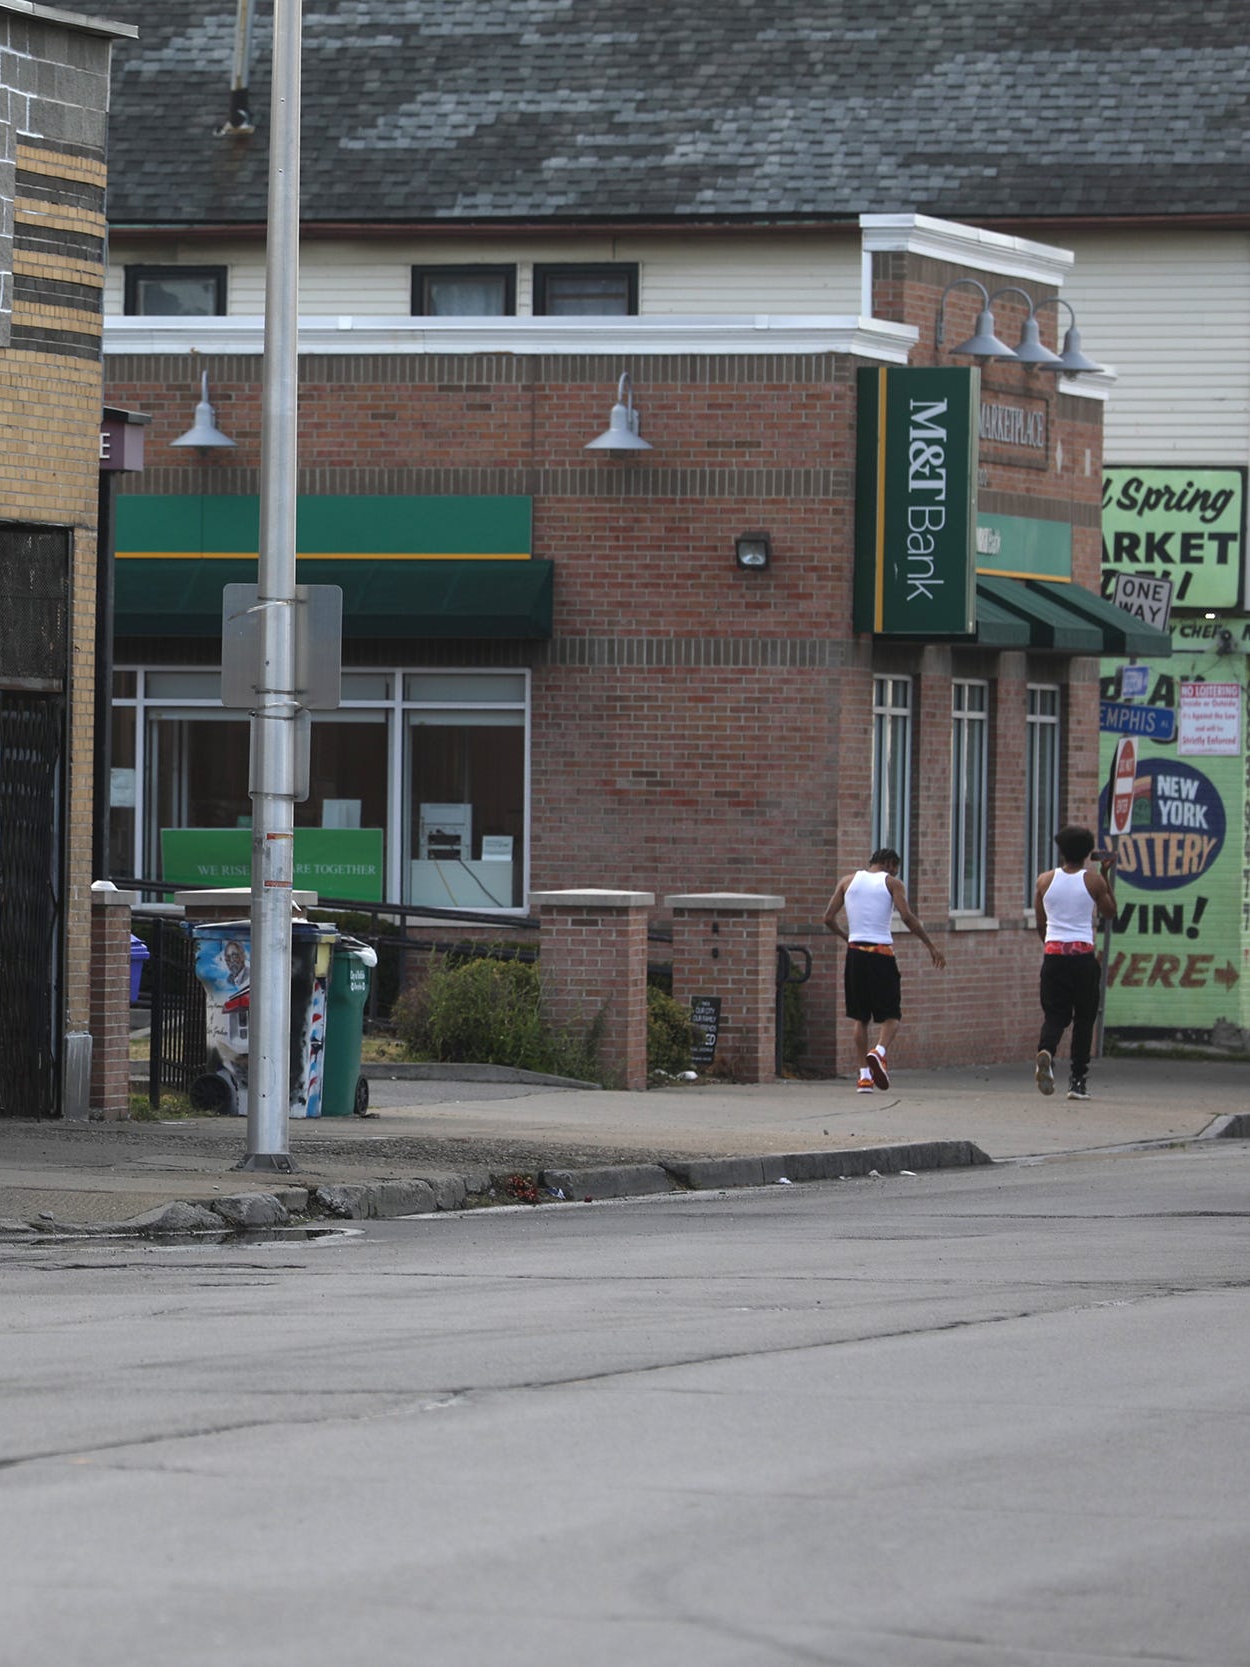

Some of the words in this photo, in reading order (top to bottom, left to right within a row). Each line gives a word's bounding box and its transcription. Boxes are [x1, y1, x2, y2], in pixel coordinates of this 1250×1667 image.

[908, 398, 947, 500] M&T
[1116, 477, 1235, 524] Spring
[906, 505, 946, 601] Bank
[1122, 580, 1165, 602] ONE
[1157, 775, 1199, 800] NEW
[1159, 800, 1209, 829] YORK
[198, 865, 218, 876] WE
[222, 865, 249, 876] RISE
[313, 864, 375, 875] TOGETHER
